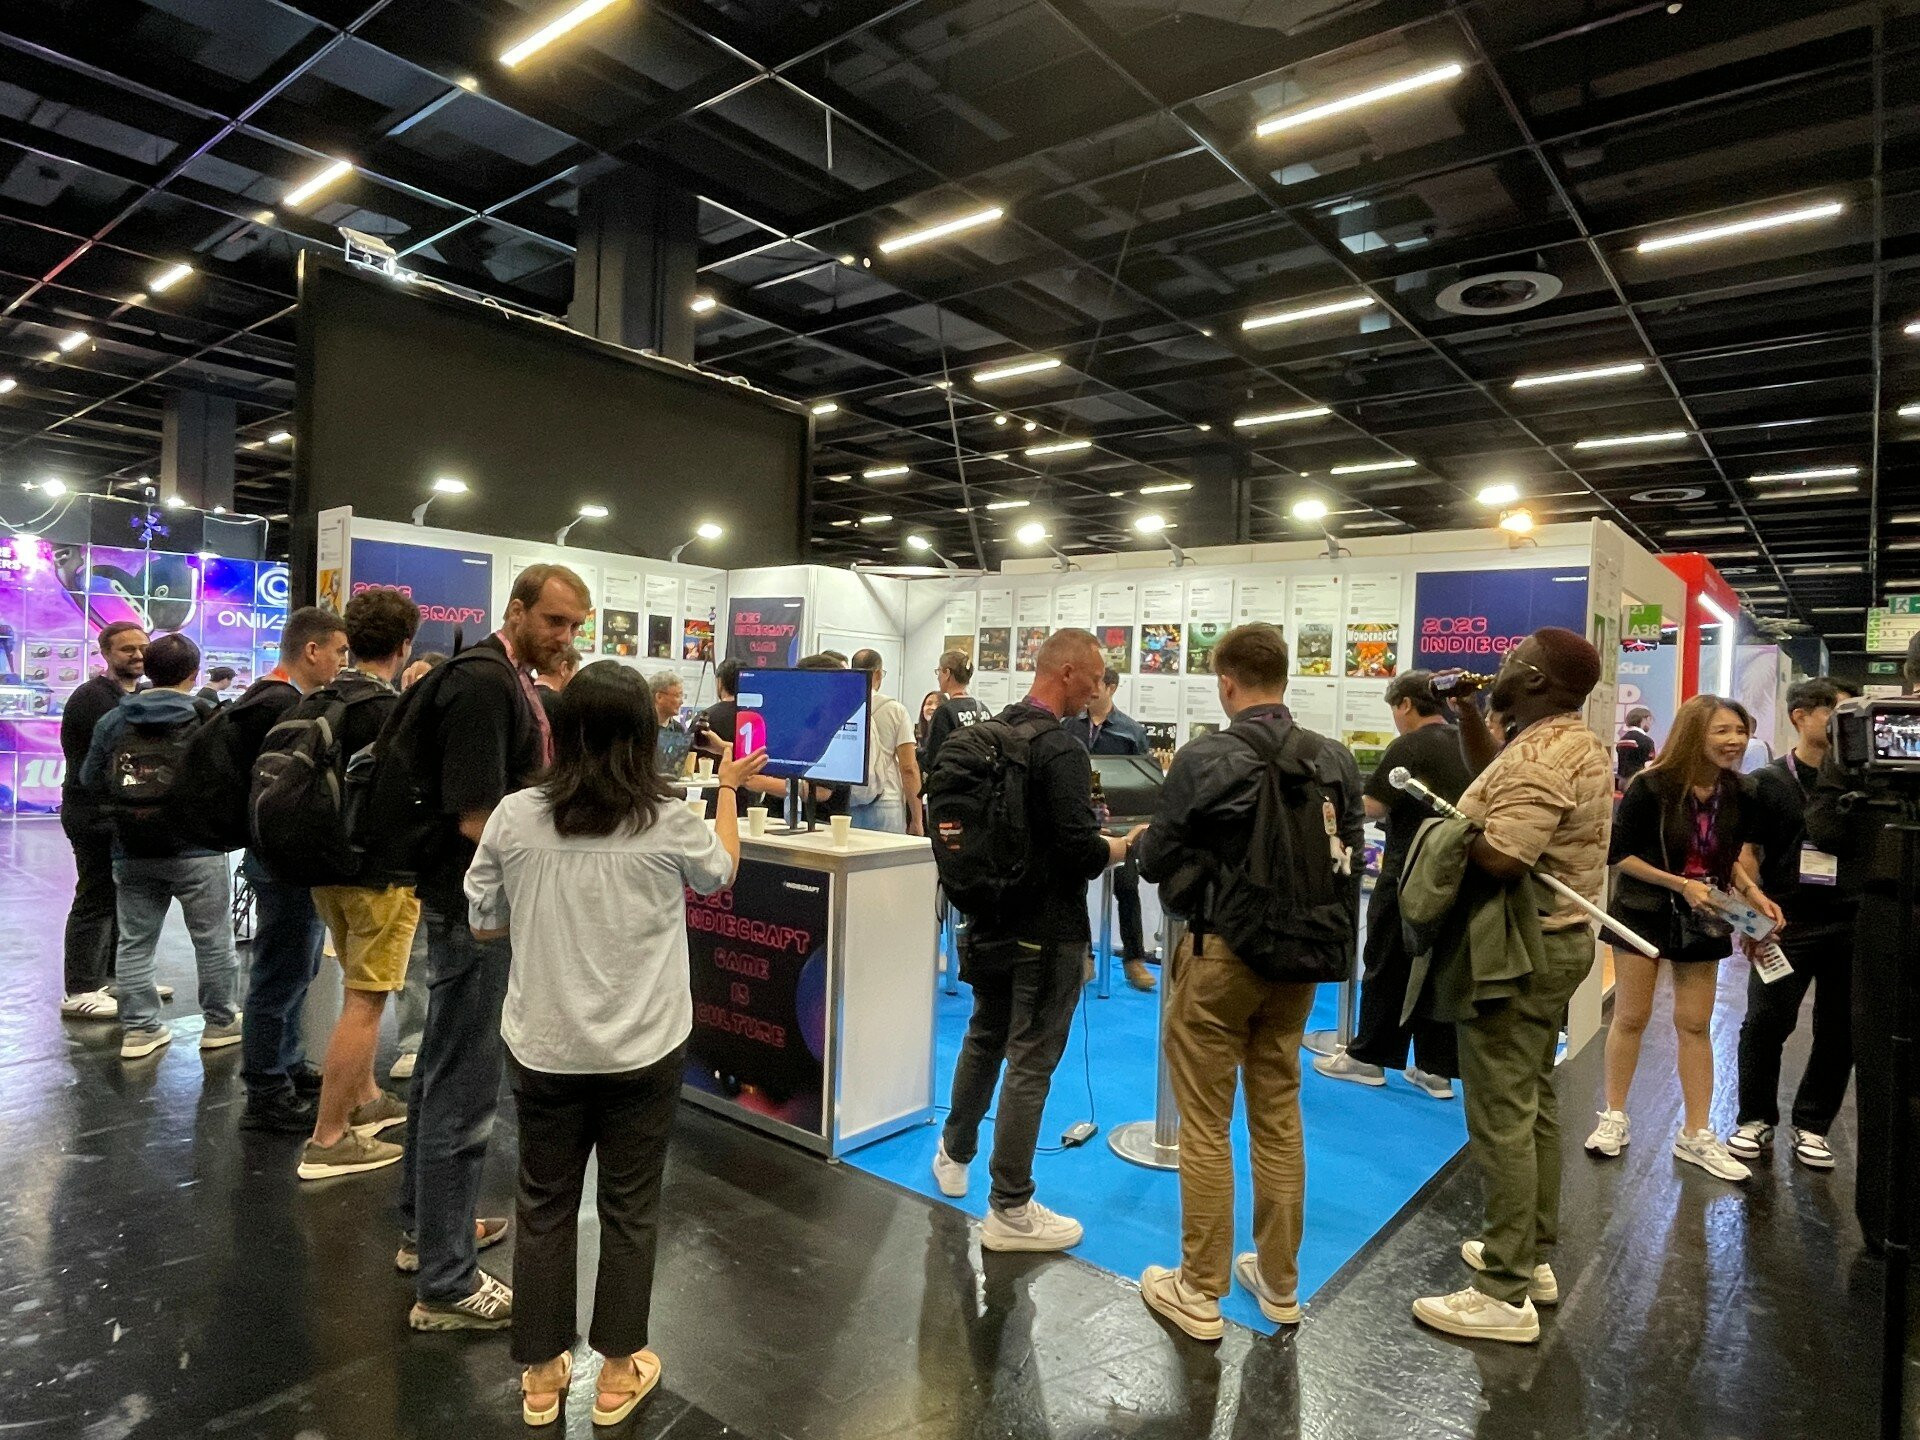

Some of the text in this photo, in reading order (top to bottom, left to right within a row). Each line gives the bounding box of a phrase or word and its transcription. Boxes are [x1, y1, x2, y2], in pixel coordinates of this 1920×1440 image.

[417, 605, 485, 623] CRAFT
[1631, 624, 1659, 636] A38
[1421, 636, 1528, 653] INDIEC
[1617, 661, 1651, 674] Star
[740, 722, 752, 754] 1
[687, 907, 810, 954] NDIECRAFT
[714, 947, 770, 981] GAME
